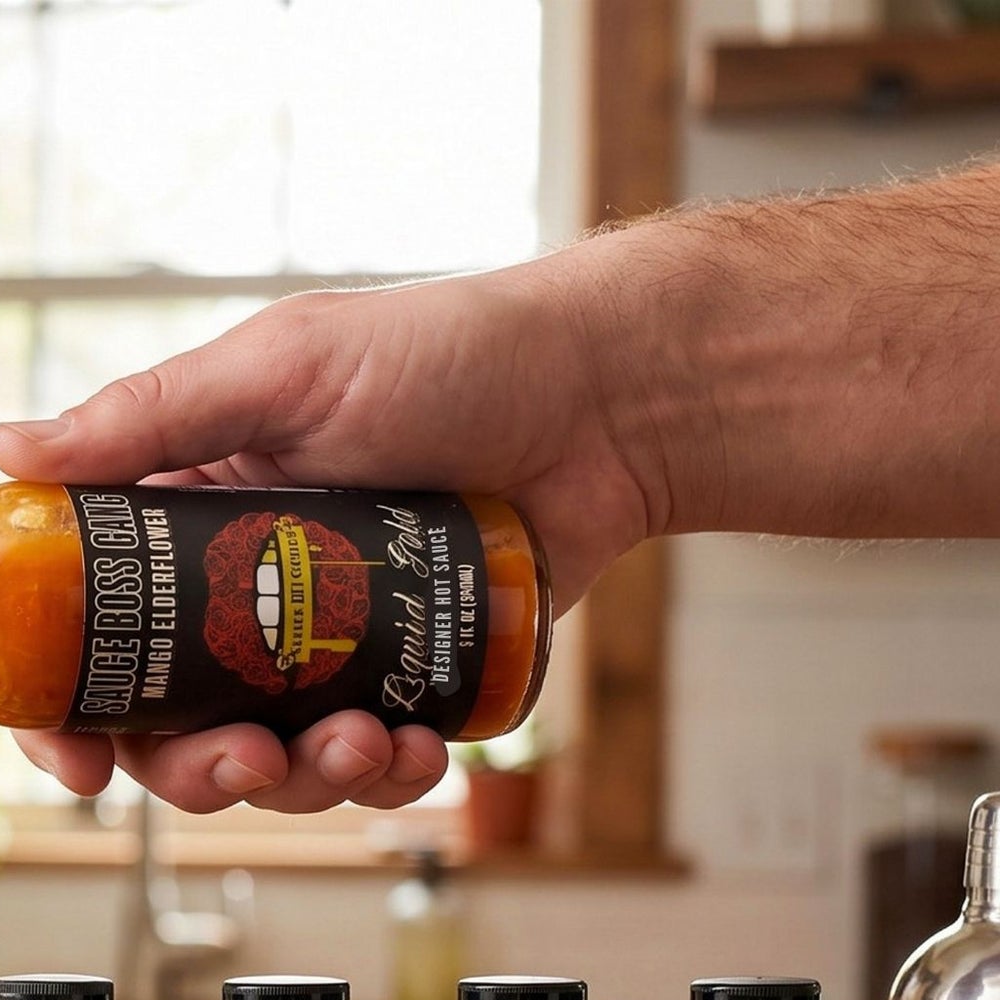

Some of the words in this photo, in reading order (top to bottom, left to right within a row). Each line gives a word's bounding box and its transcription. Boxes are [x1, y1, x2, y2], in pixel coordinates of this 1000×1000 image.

[80, 493, 139, 550] GANG
[428, 525, 450, 572] SAUCE
[93, 557, 143, 631] BOSS
[141, 508, 177, 630] ELDERFLOWER
[434, 578, 451, 606] HOT
[80, 638, 141, 714] SAUCE
[141, 638, 174, 699] MANGO
[433, 612, 452, 683] DESIGNER
